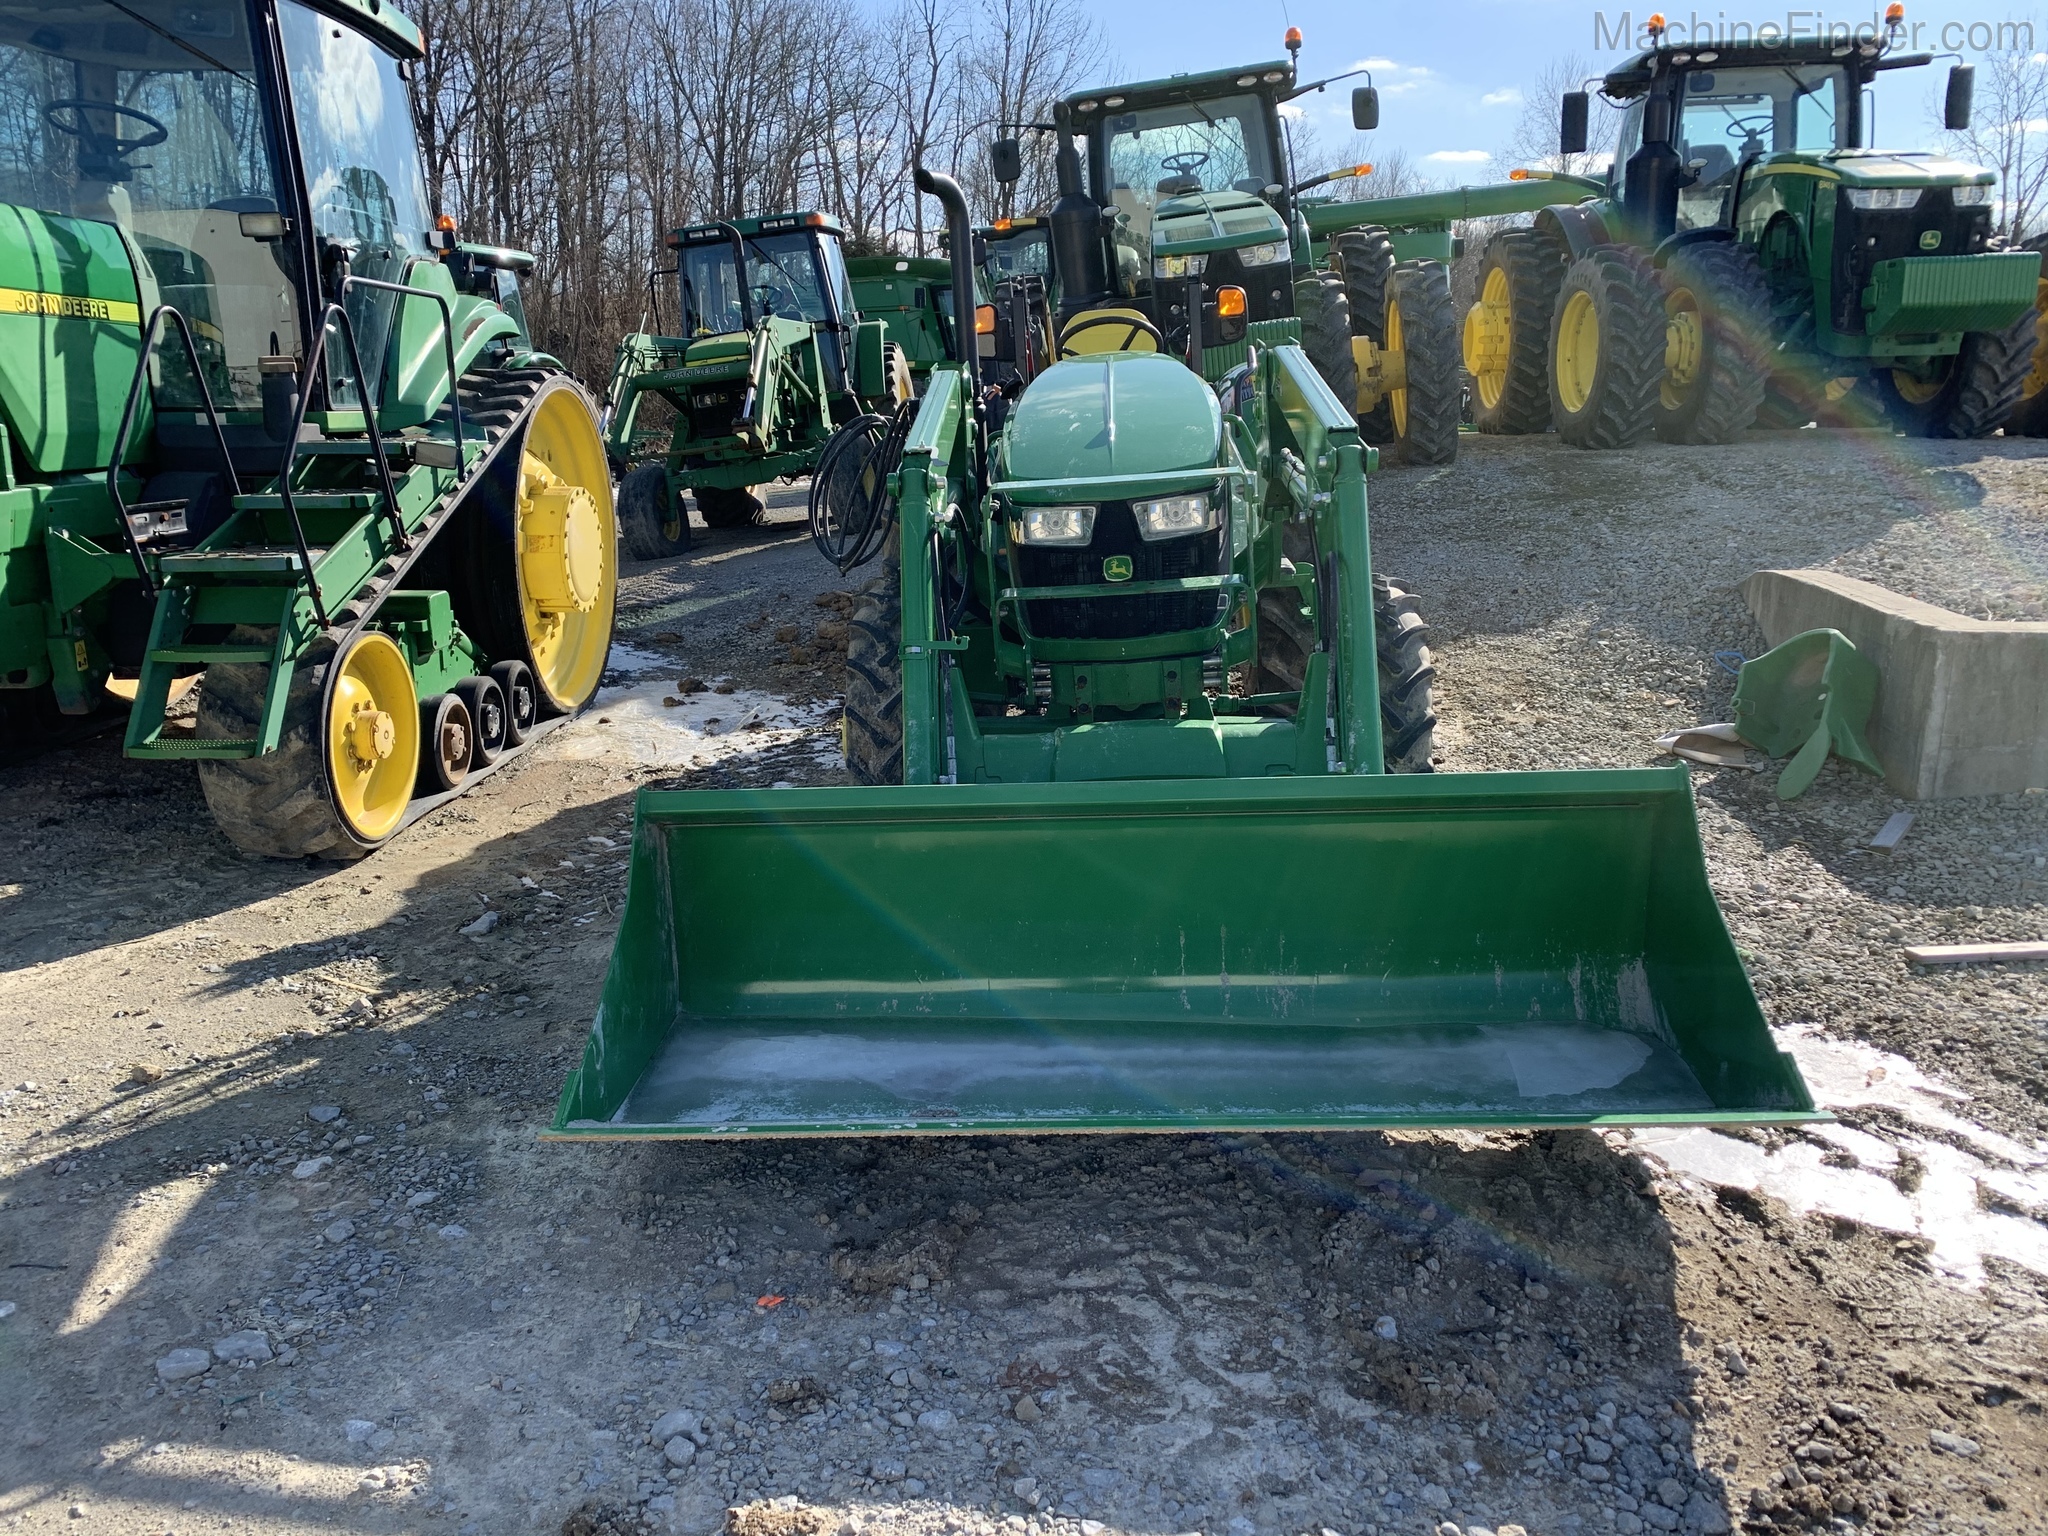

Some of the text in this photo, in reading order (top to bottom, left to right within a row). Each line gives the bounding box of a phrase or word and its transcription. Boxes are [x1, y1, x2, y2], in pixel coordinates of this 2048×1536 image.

[16, 293, 110, 320] JOHN DEERE
[663, 365, 729, 380] JOHN DEERE
